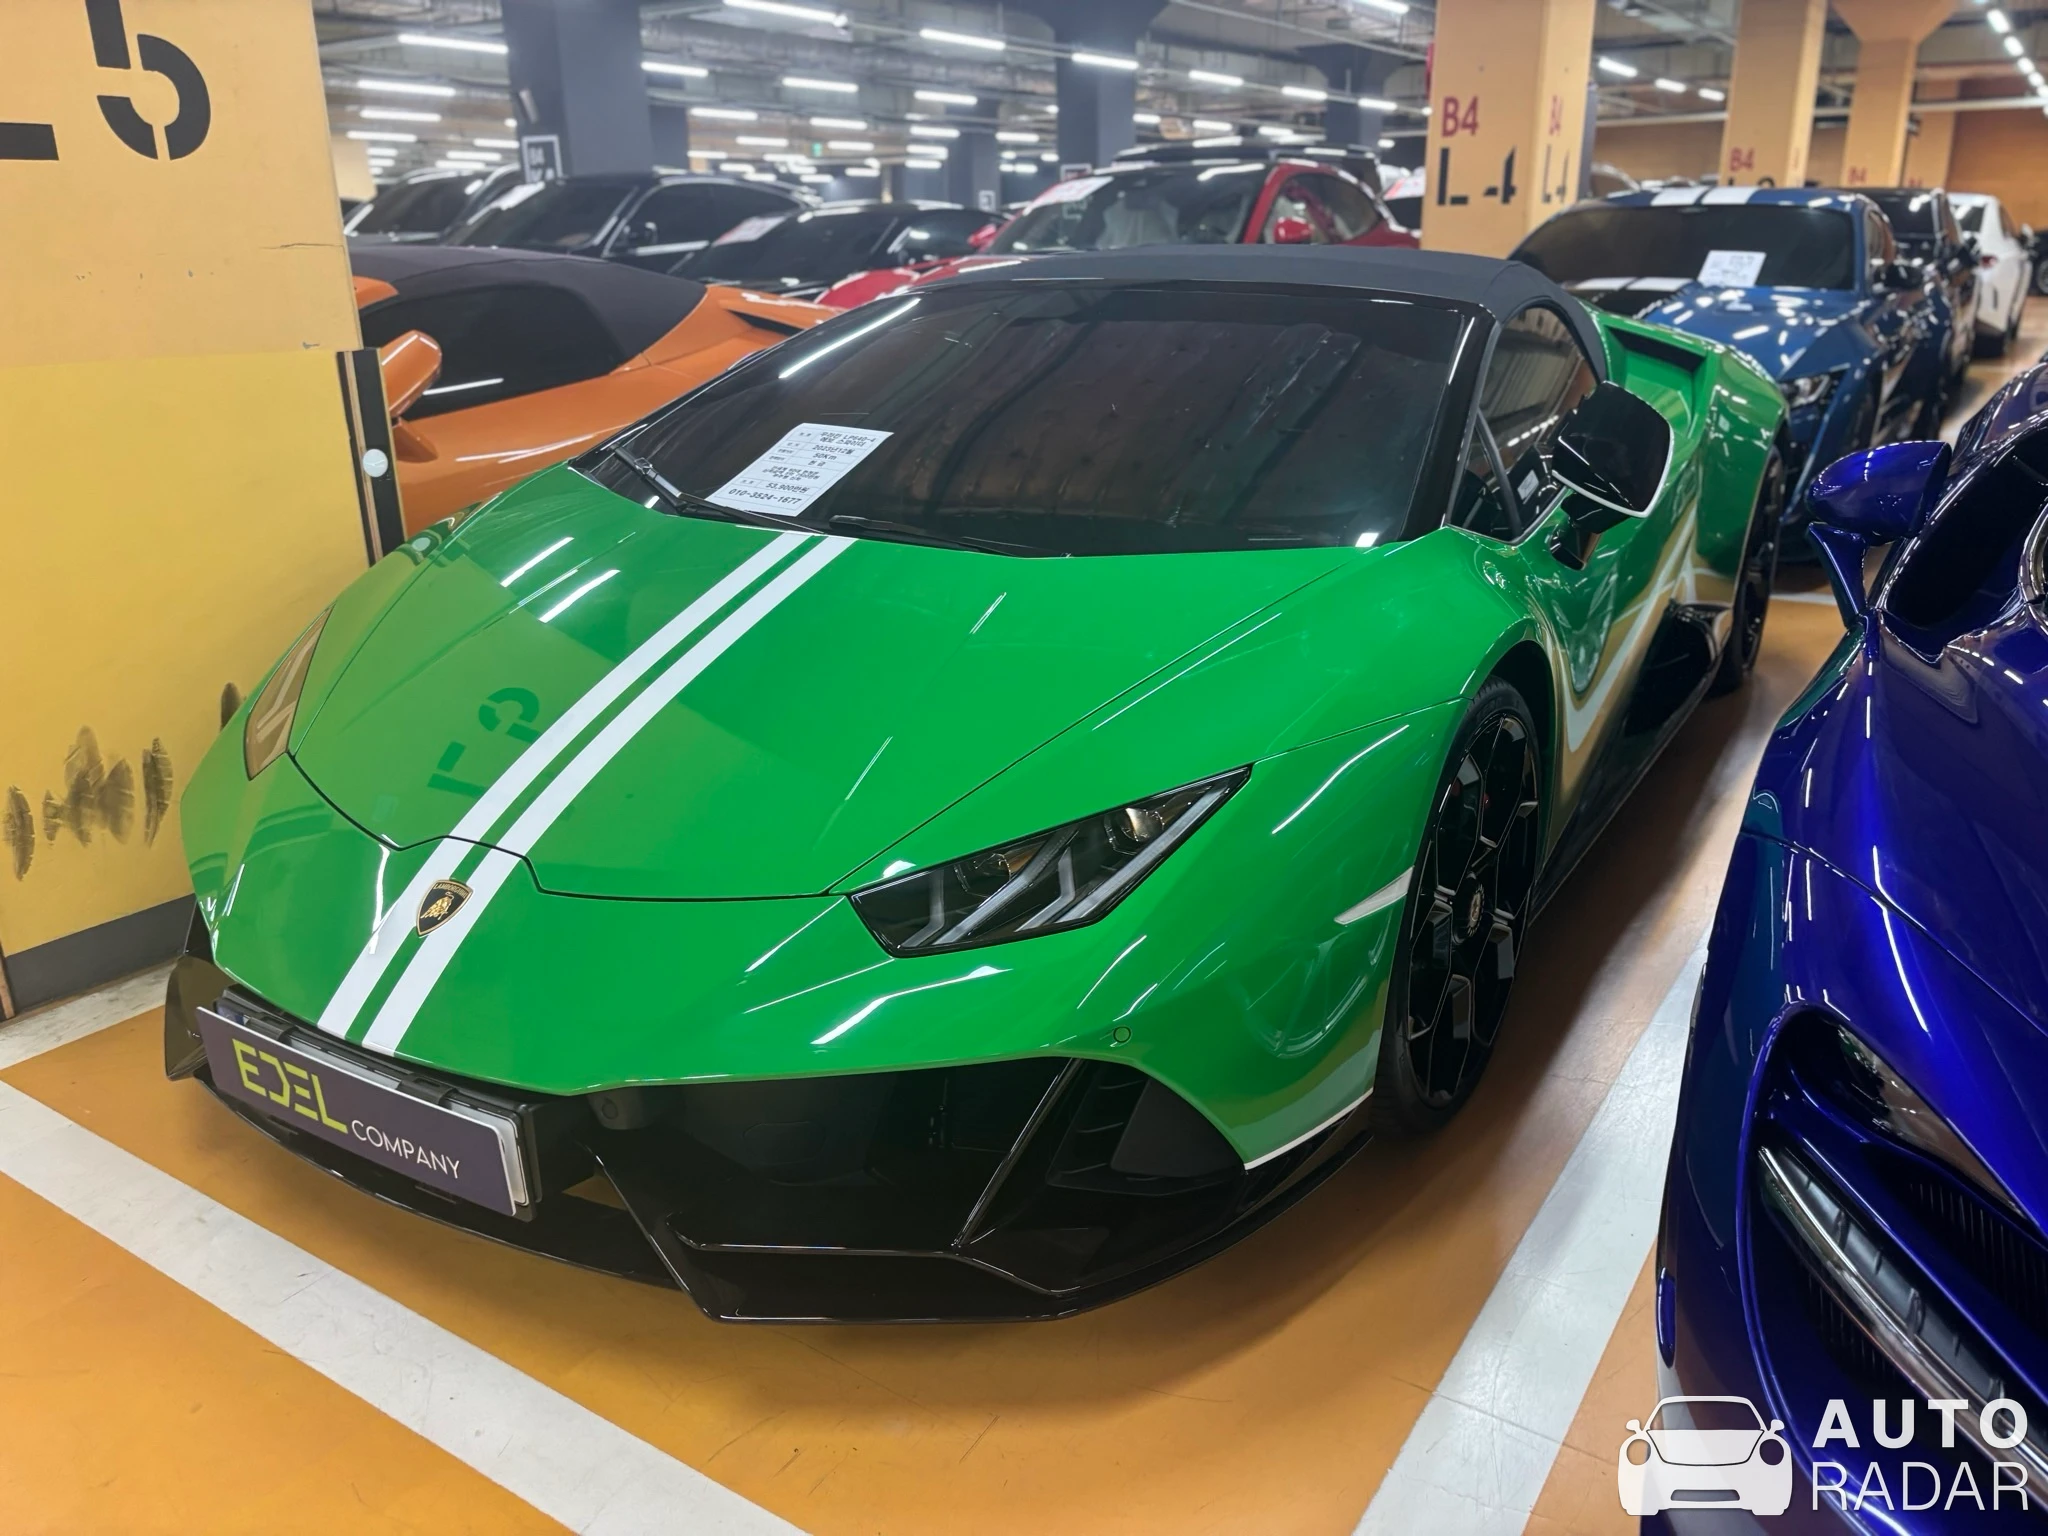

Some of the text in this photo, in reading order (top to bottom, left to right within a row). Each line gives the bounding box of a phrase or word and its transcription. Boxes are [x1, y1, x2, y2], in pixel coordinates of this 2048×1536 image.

[1442, 96, 1479, 137] B4
[1730, 147, 1754, 171] B4
[728, 488, 802, 505] 010-3524-1677
[231, 1038, 460, 1179] EDEL COMPANY
